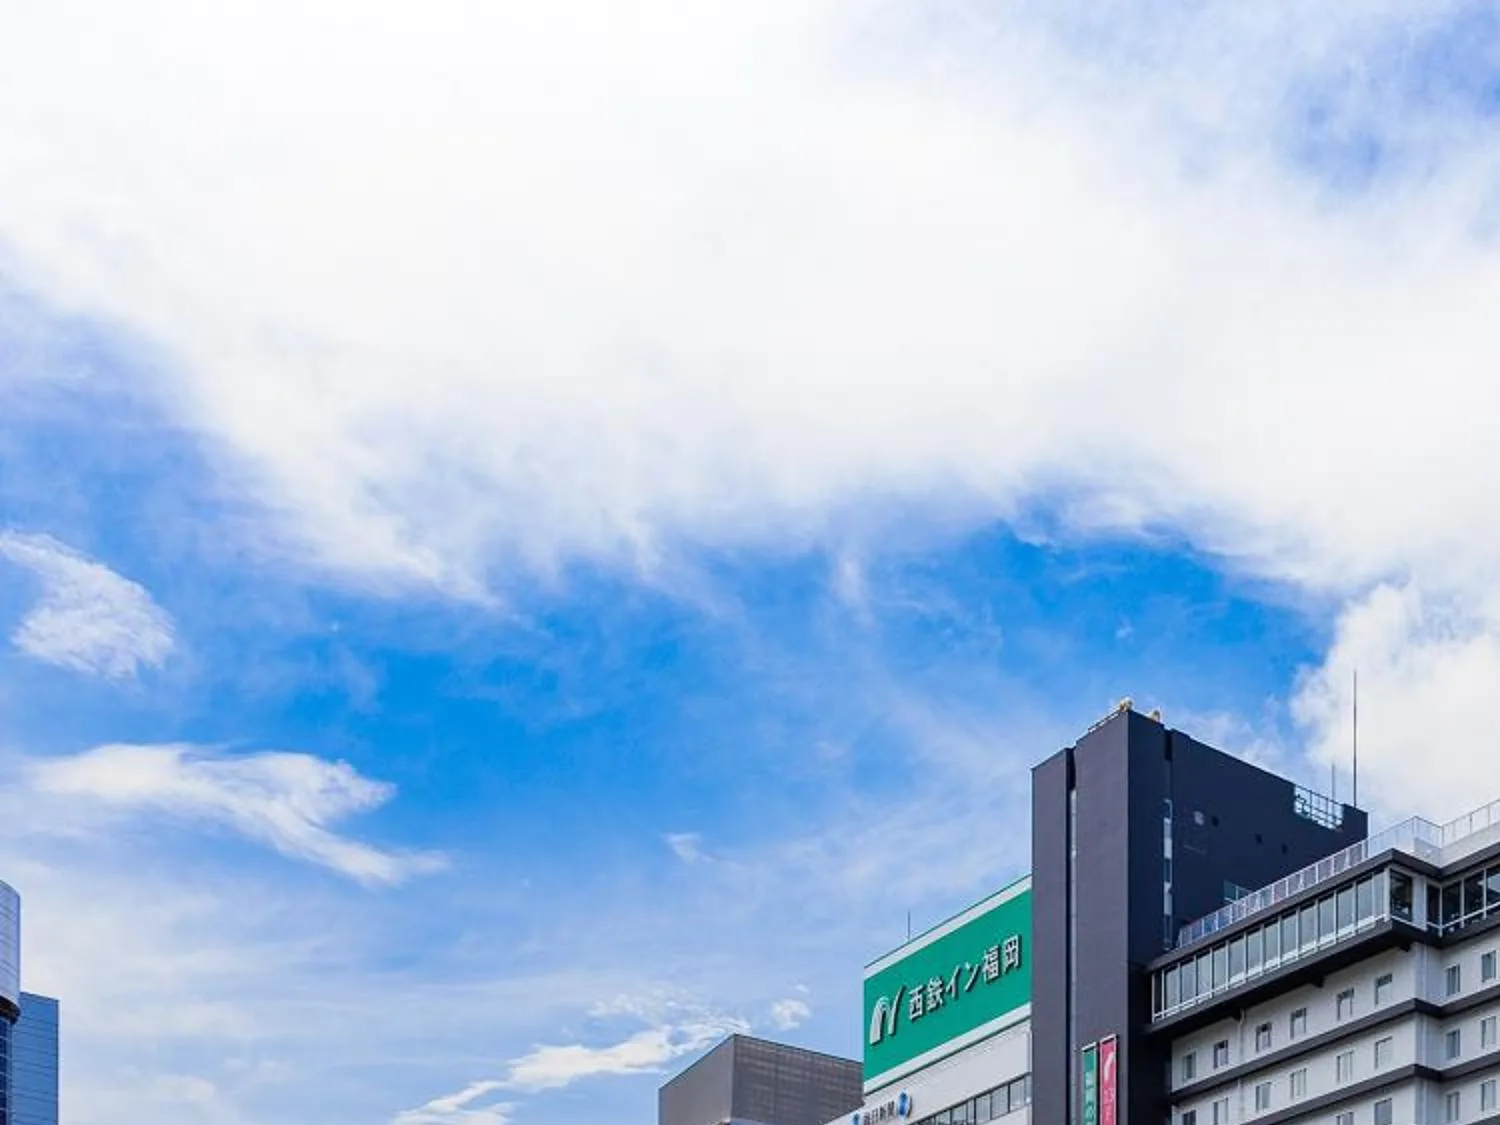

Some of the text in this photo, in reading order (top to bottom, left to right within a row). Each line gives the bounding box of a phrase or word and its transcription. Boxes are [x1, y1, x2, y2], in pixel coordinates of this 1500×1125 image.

[907, 934, 1021, 1022] 西鉄イン福岡
